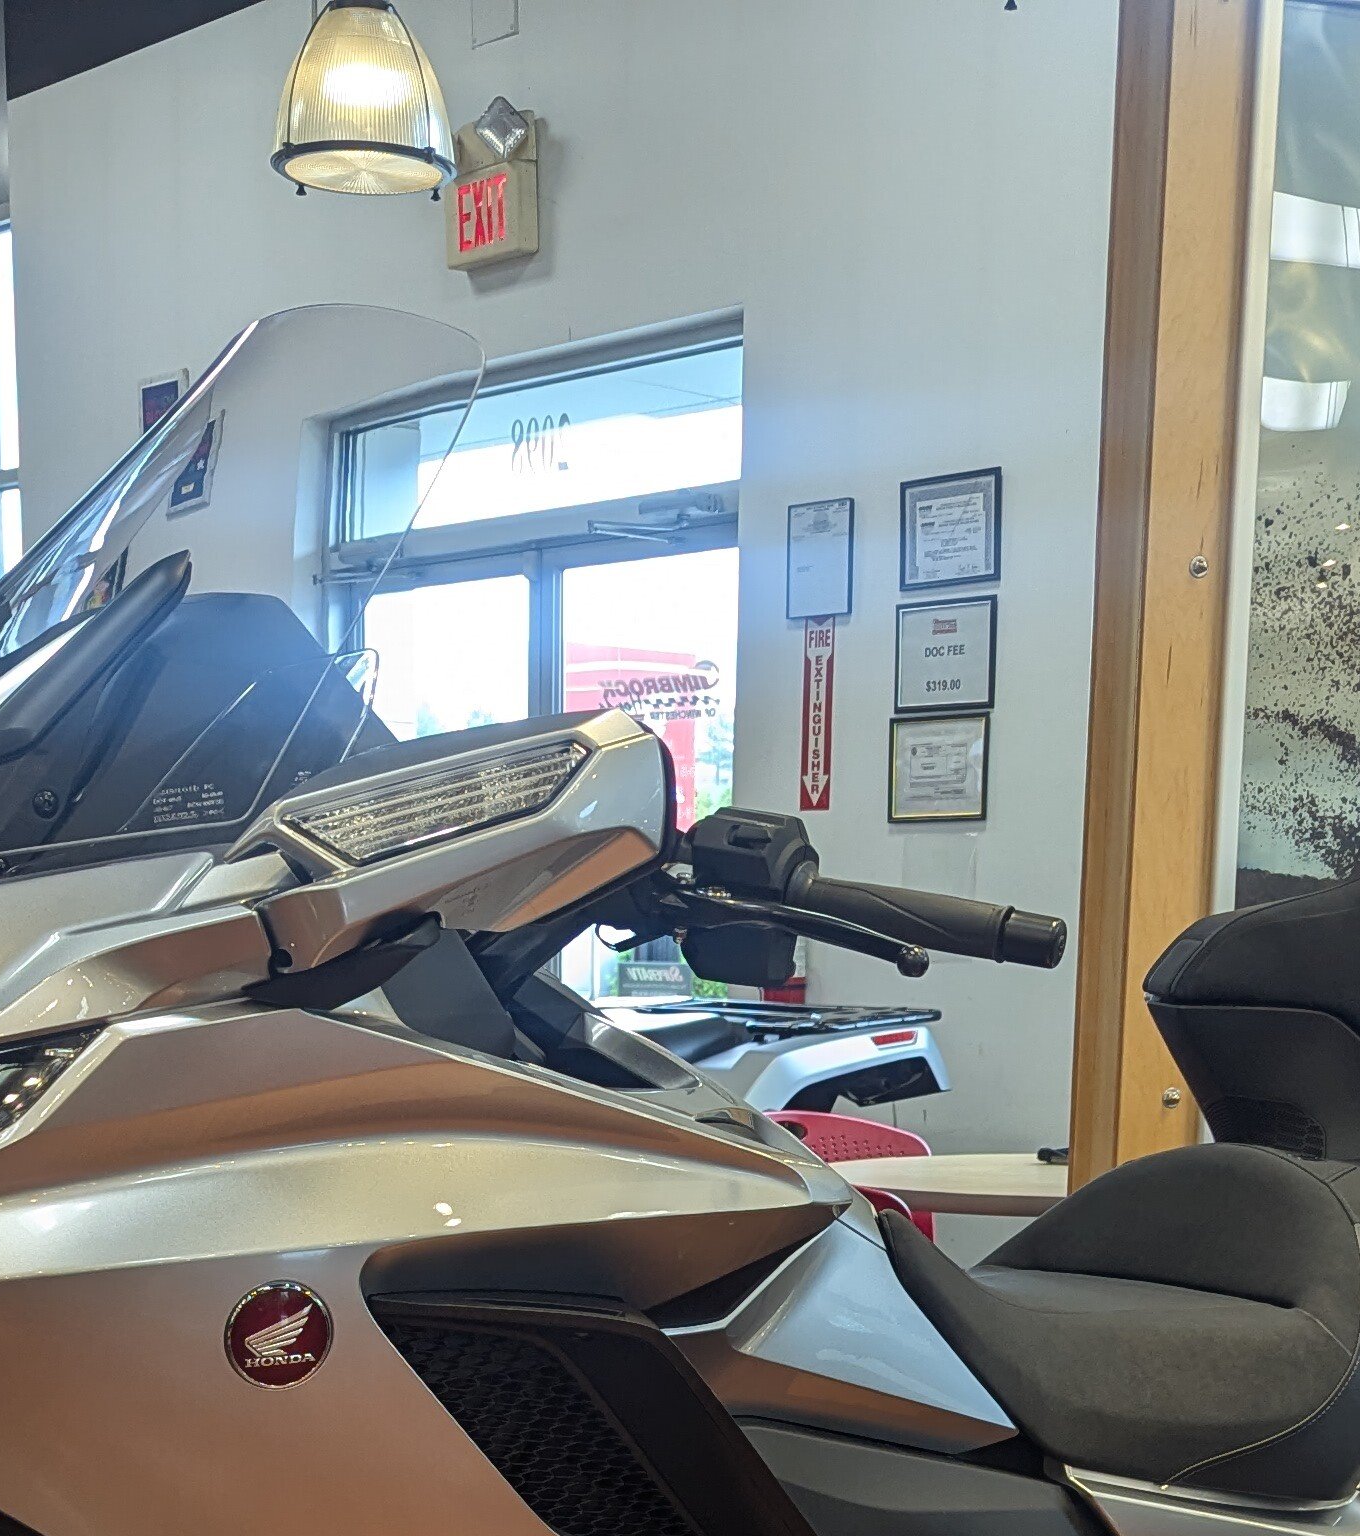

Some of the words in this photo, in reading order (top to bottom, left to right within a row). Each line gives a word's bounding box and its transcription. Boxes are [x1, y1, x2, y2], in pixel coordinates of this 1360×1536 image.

[457, 173, 507, 253] EXIT
[808, 628, 831, 649] FIRE
[924, 646, 945, 658] DOC
[947, 644, 966, 656] FEE
[925, 679, 961, 692] $319.00
[810, 655, 824, 795] EXTINGUISHER
[244, 1352, 316, 1368] HONDA
